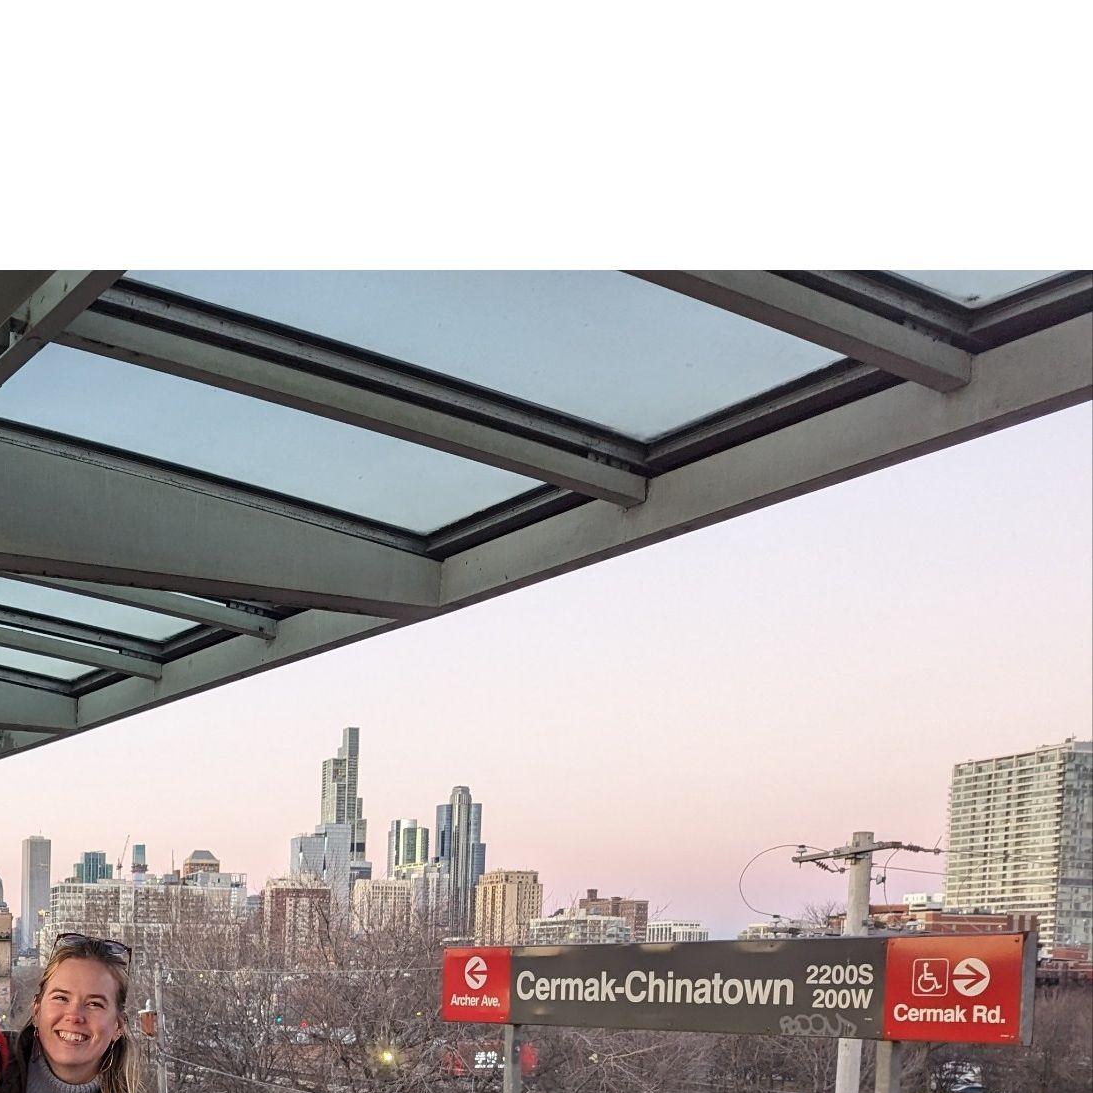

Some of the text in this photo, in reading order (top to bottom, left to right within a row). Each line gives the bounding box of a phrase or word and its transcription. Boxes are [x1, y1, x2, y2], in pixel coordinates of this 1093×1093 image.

[806, 963, 873, 985] 2200S
[516, 970, 793, 1005] Cermak-Chinatown
[450, 994, 500, 1007] Archer Ave.
[812, 988, 873, 1009] 200W
[893, 1003, 1006, 1024] Cermak Rd.
